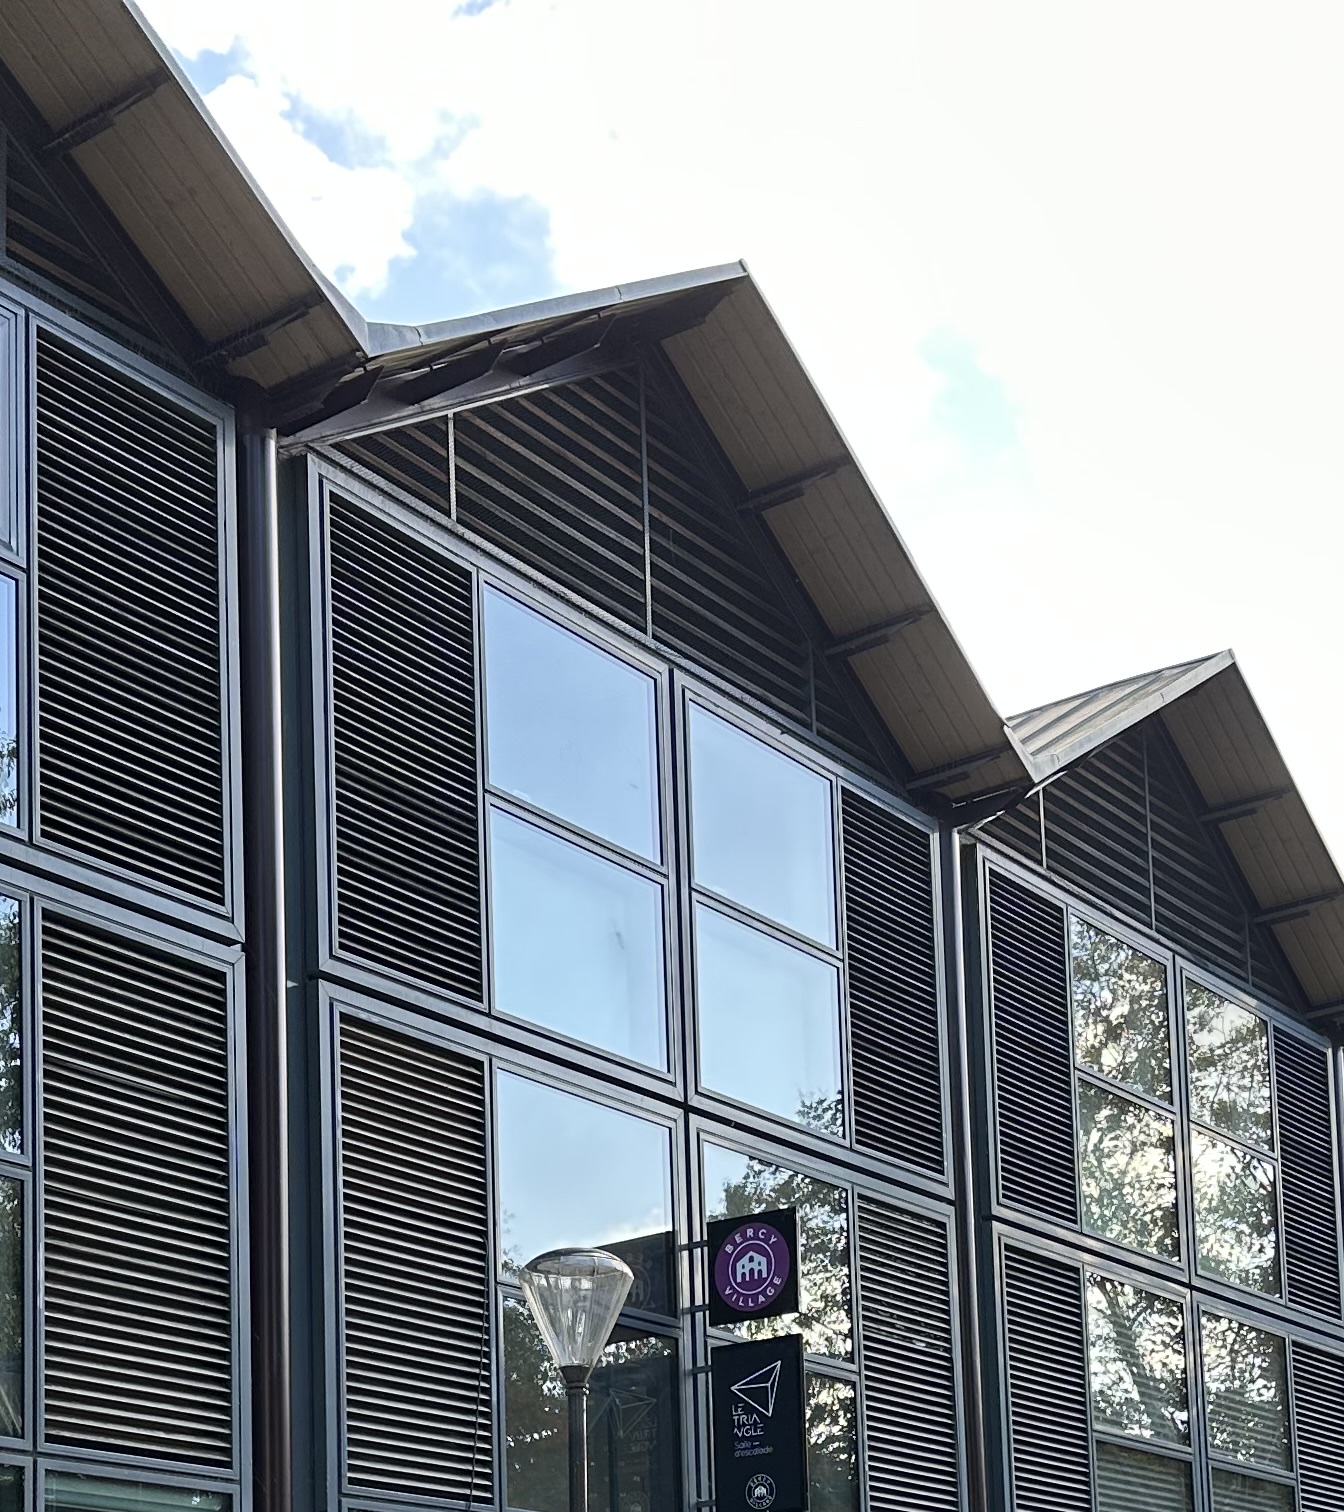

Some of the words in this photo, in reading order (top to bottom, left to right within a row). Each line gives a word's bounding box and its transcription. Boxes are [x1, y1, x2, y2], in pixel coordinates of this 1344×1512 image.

[725, 1228, 777, 1254] BERCY
[725, 1276, 782, 1307] VILLAGE
[732, 1403, 744, 1415] LE
[733, 1413, 761, 1426] TRIA
